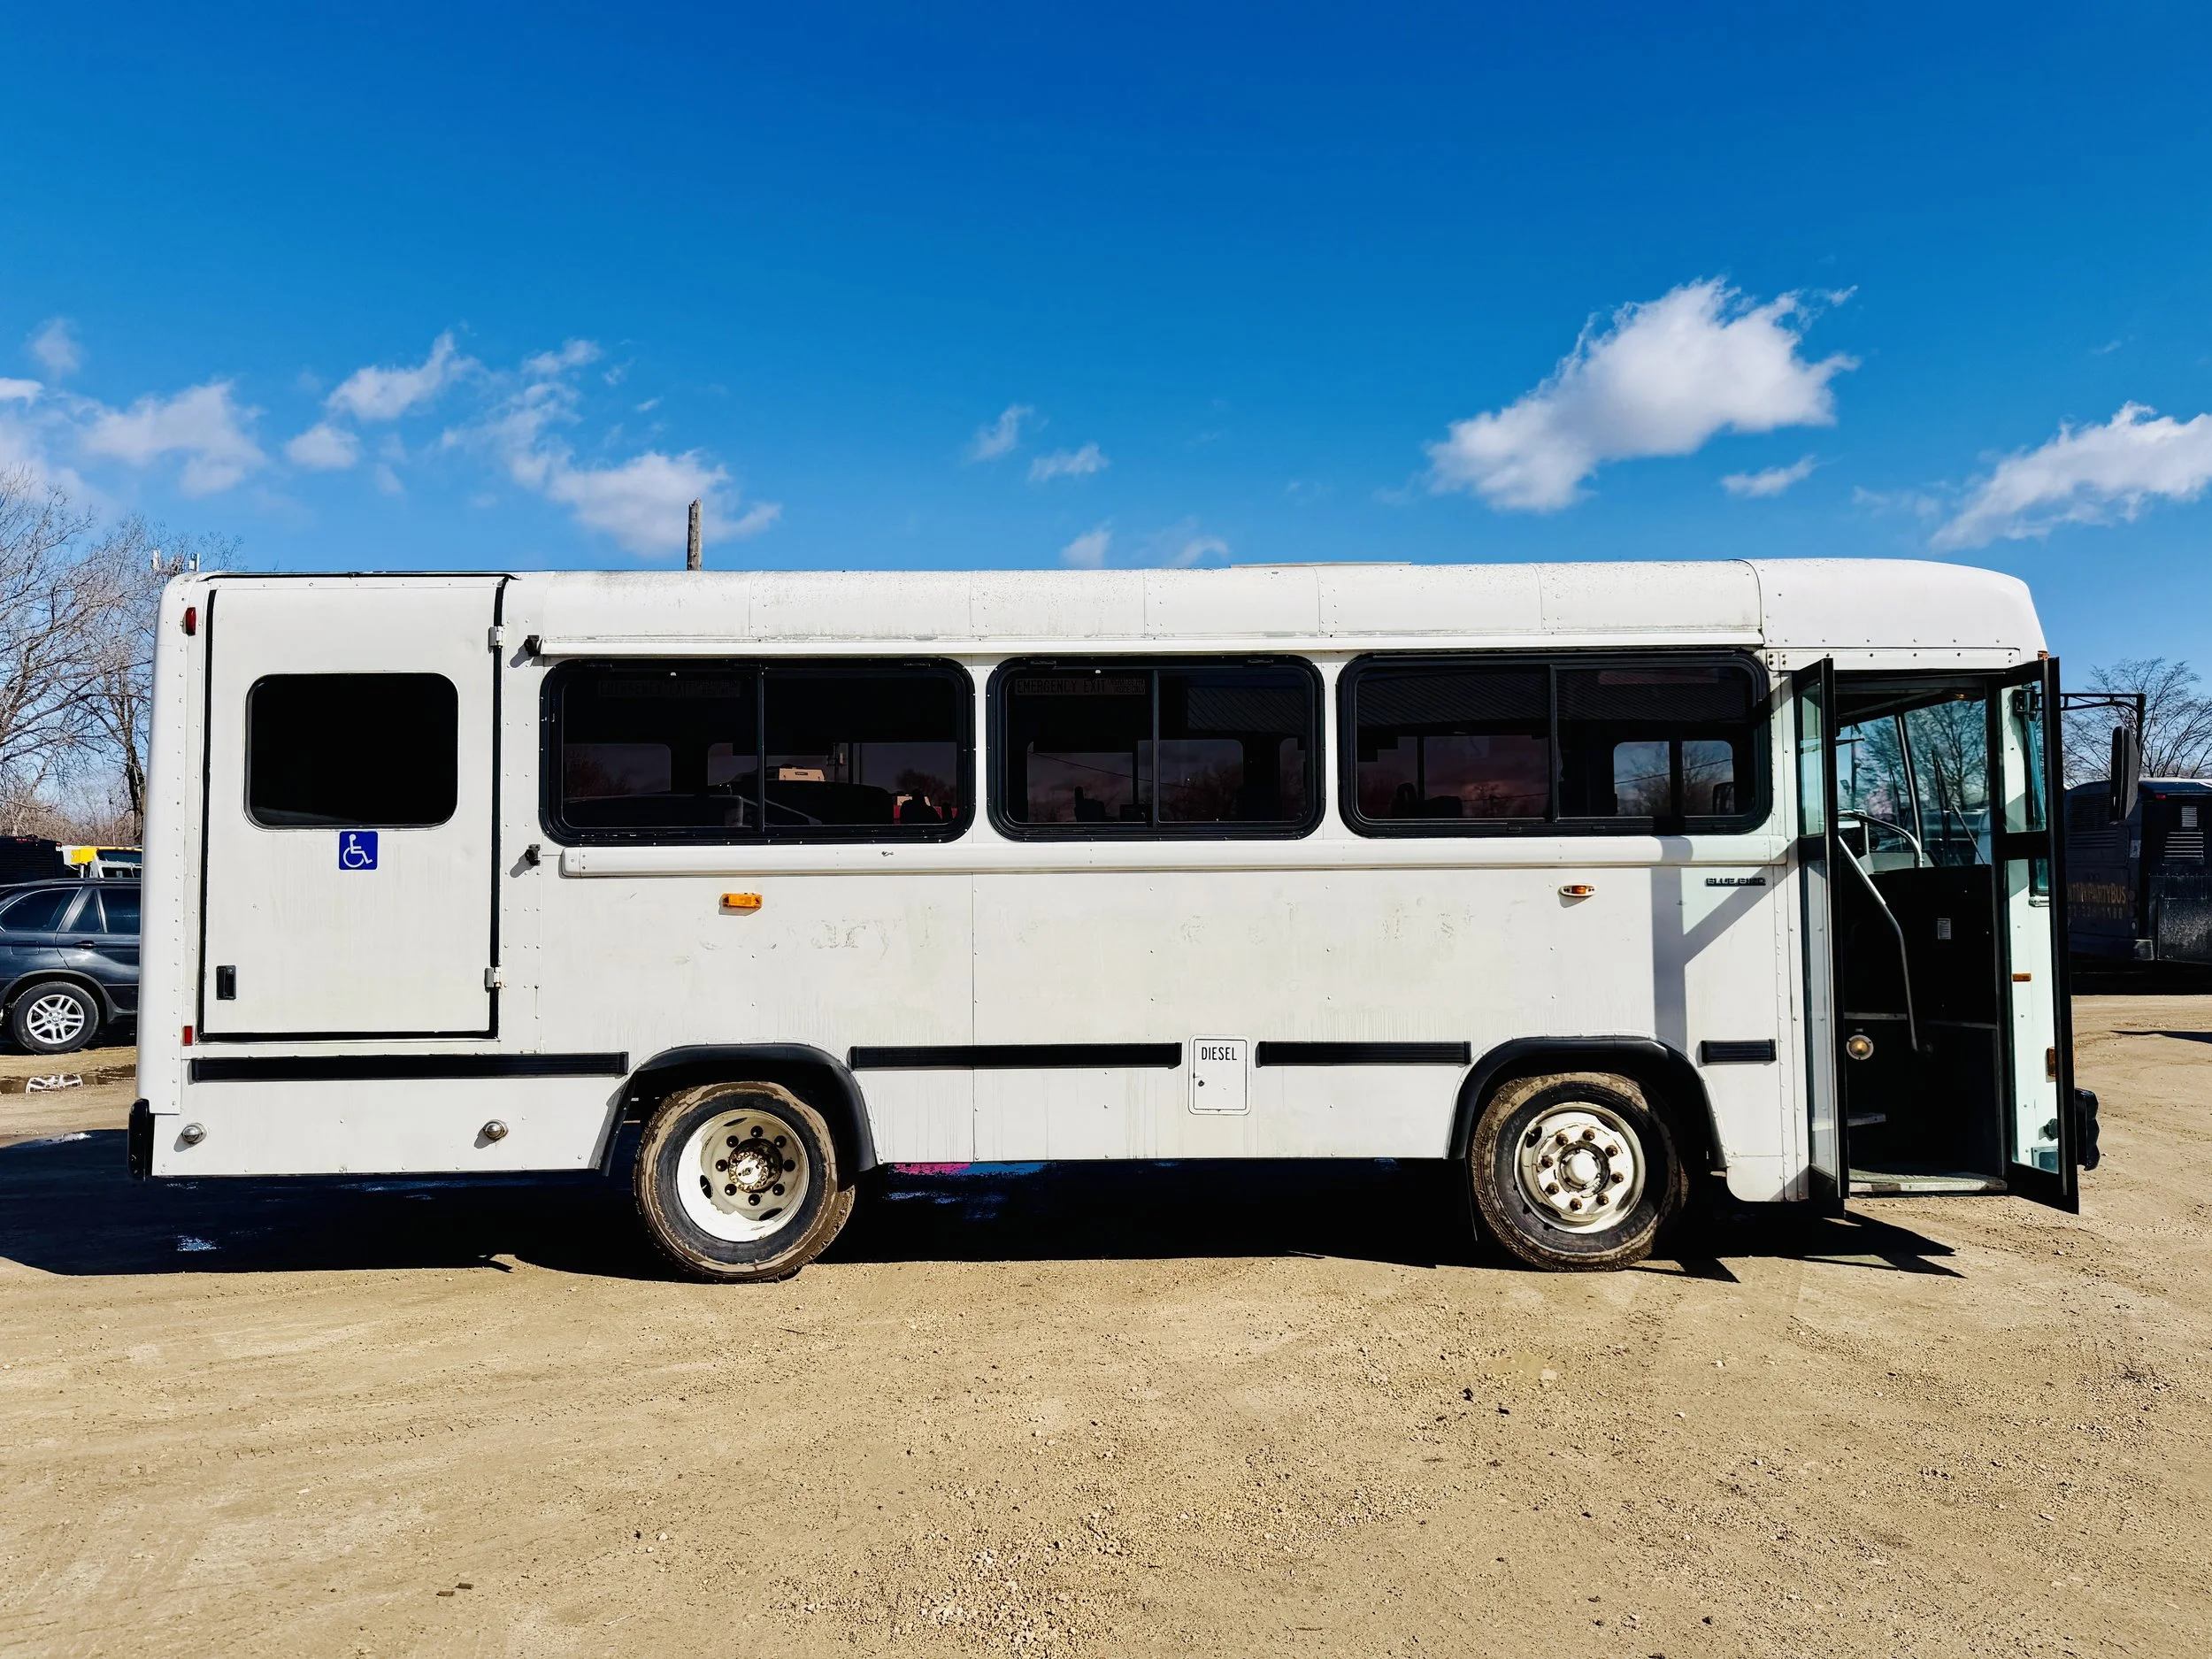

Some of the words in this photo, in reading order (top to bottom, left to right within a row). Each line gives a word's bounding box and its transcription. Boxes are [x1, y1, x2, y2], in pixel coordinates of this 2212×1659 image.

[1017, 680, 1077, 694] EMERGENCY
[1083, 680, 1107, 694] EXIT
[1706, 878, 1735, 887] BLUE
[1738, 877, 1766, 887] BIRD
[1202, 1047, 1237, 1060] DIESEL
